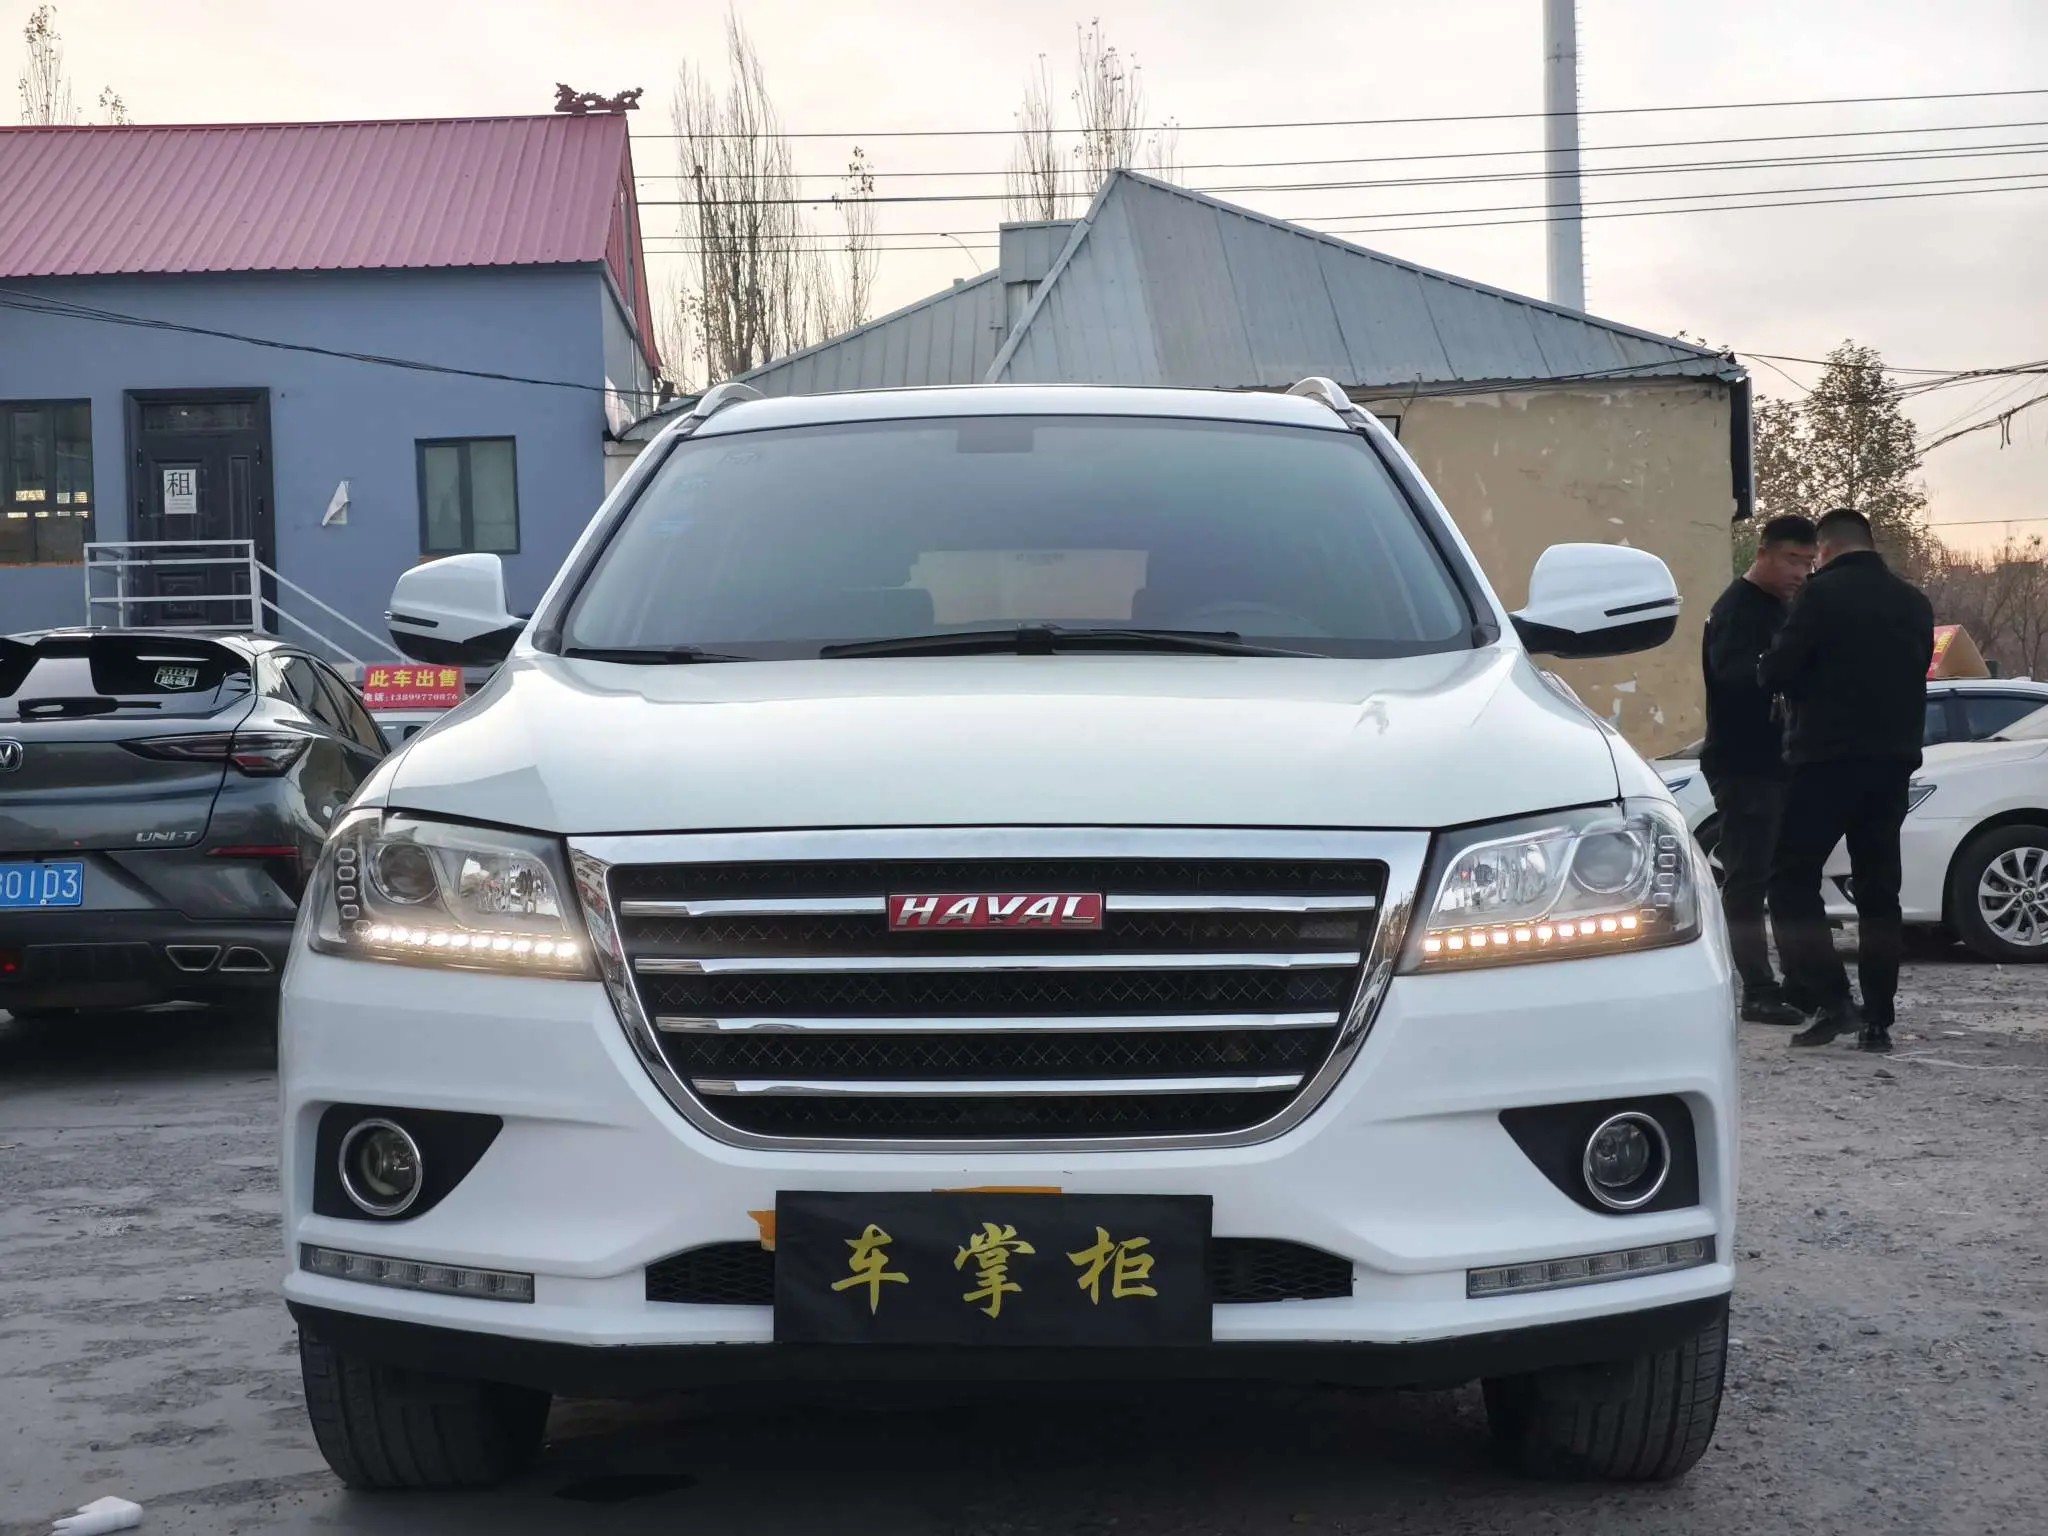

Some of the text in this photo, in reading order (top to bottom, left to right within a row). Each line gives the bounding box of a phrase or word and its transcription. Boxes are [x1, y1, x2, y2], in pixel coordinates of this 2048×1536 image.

[166, 472, 193, 497] 租
[368, 669, 457, 688] 此车出售
[136, 831, 198, 842] UNI-T
[0, 869, 78, 899] 01D3
[896, 896, 1095, 926] HAVAL
[831, 1222, 1158, 1319] 车掌柜
